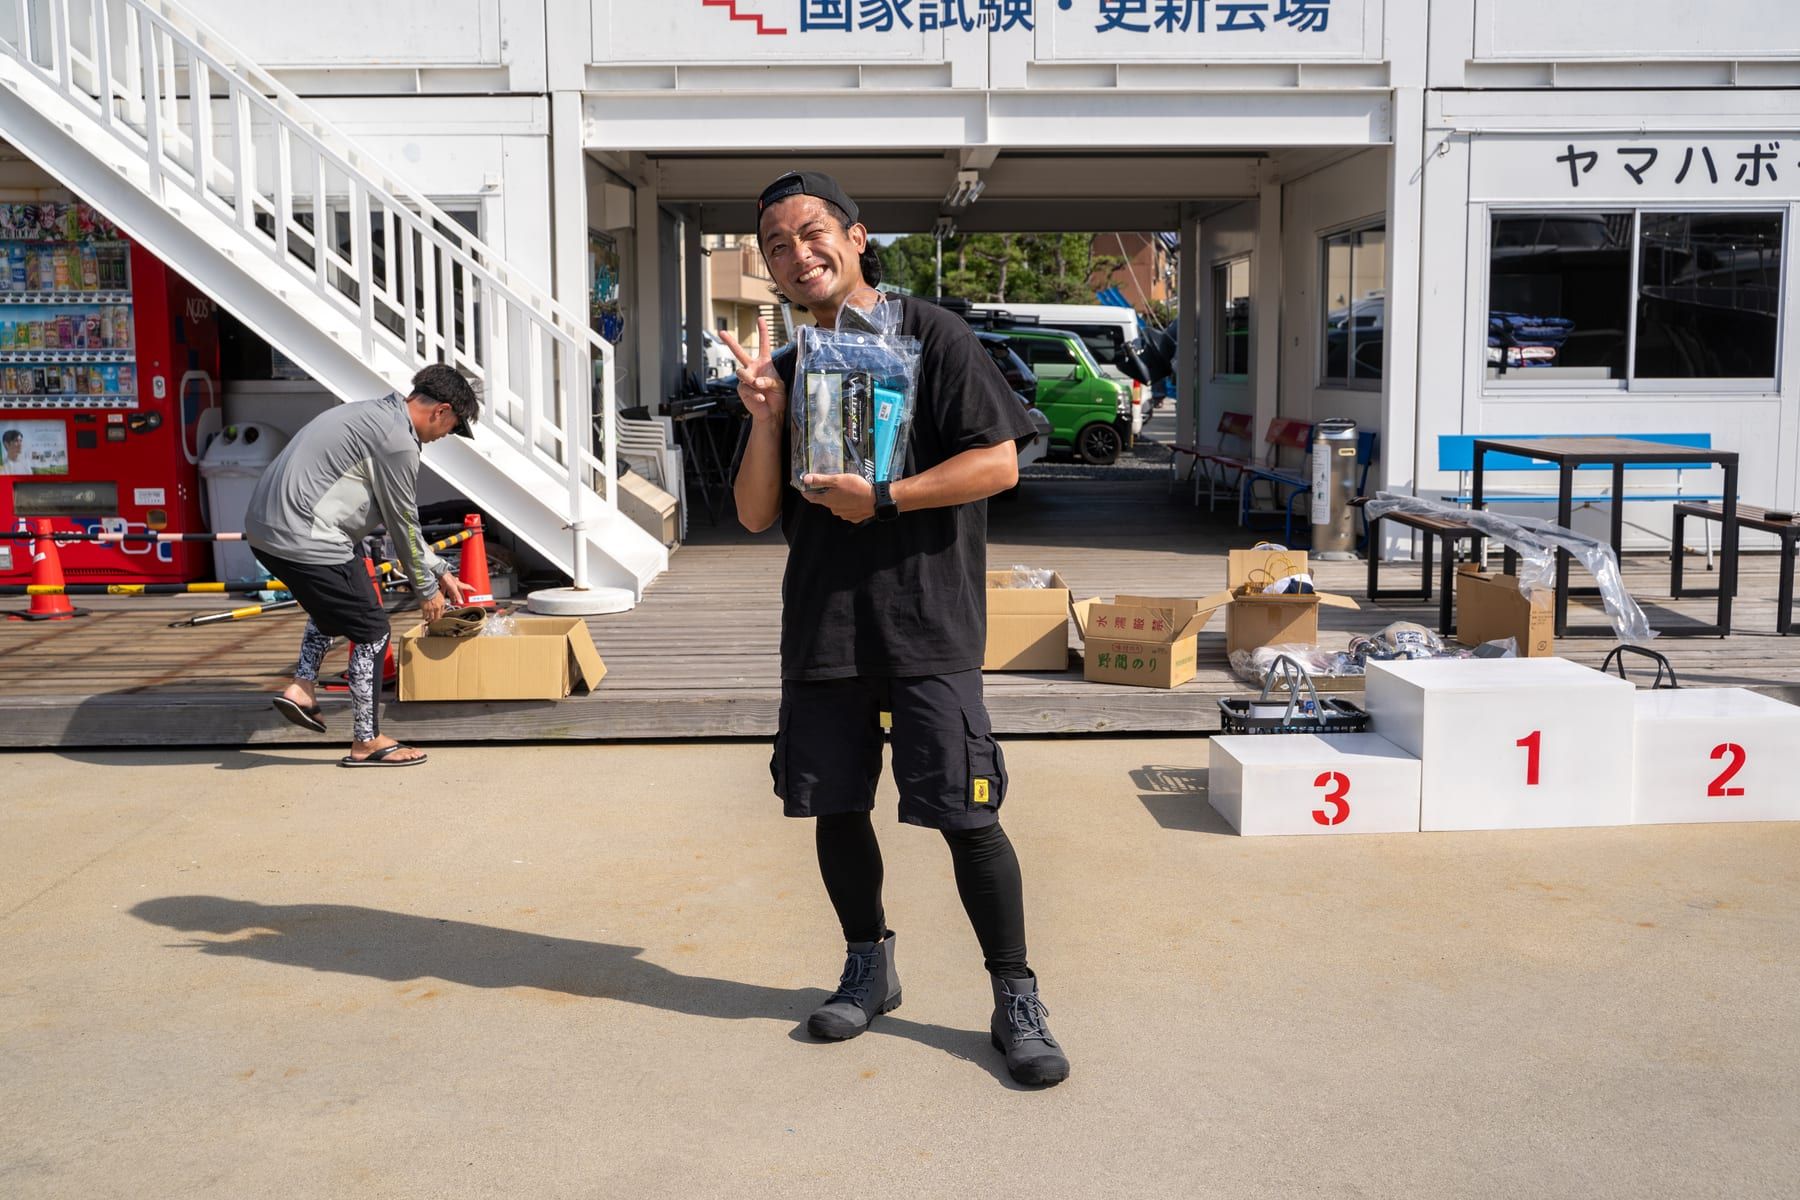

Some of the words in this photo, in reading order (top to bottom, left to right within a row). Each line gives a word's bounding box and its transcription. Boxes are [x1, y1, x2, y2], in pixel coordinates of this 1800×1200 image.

[1555, 141, 1800, 188] ヤマハボ
[1098, 652, 1157, 672] 野間のり
[1516, 730, 1541, 785] 1
[1707, 743, 1746, 797] 2
[1312, 772, 1350, 826] 3
